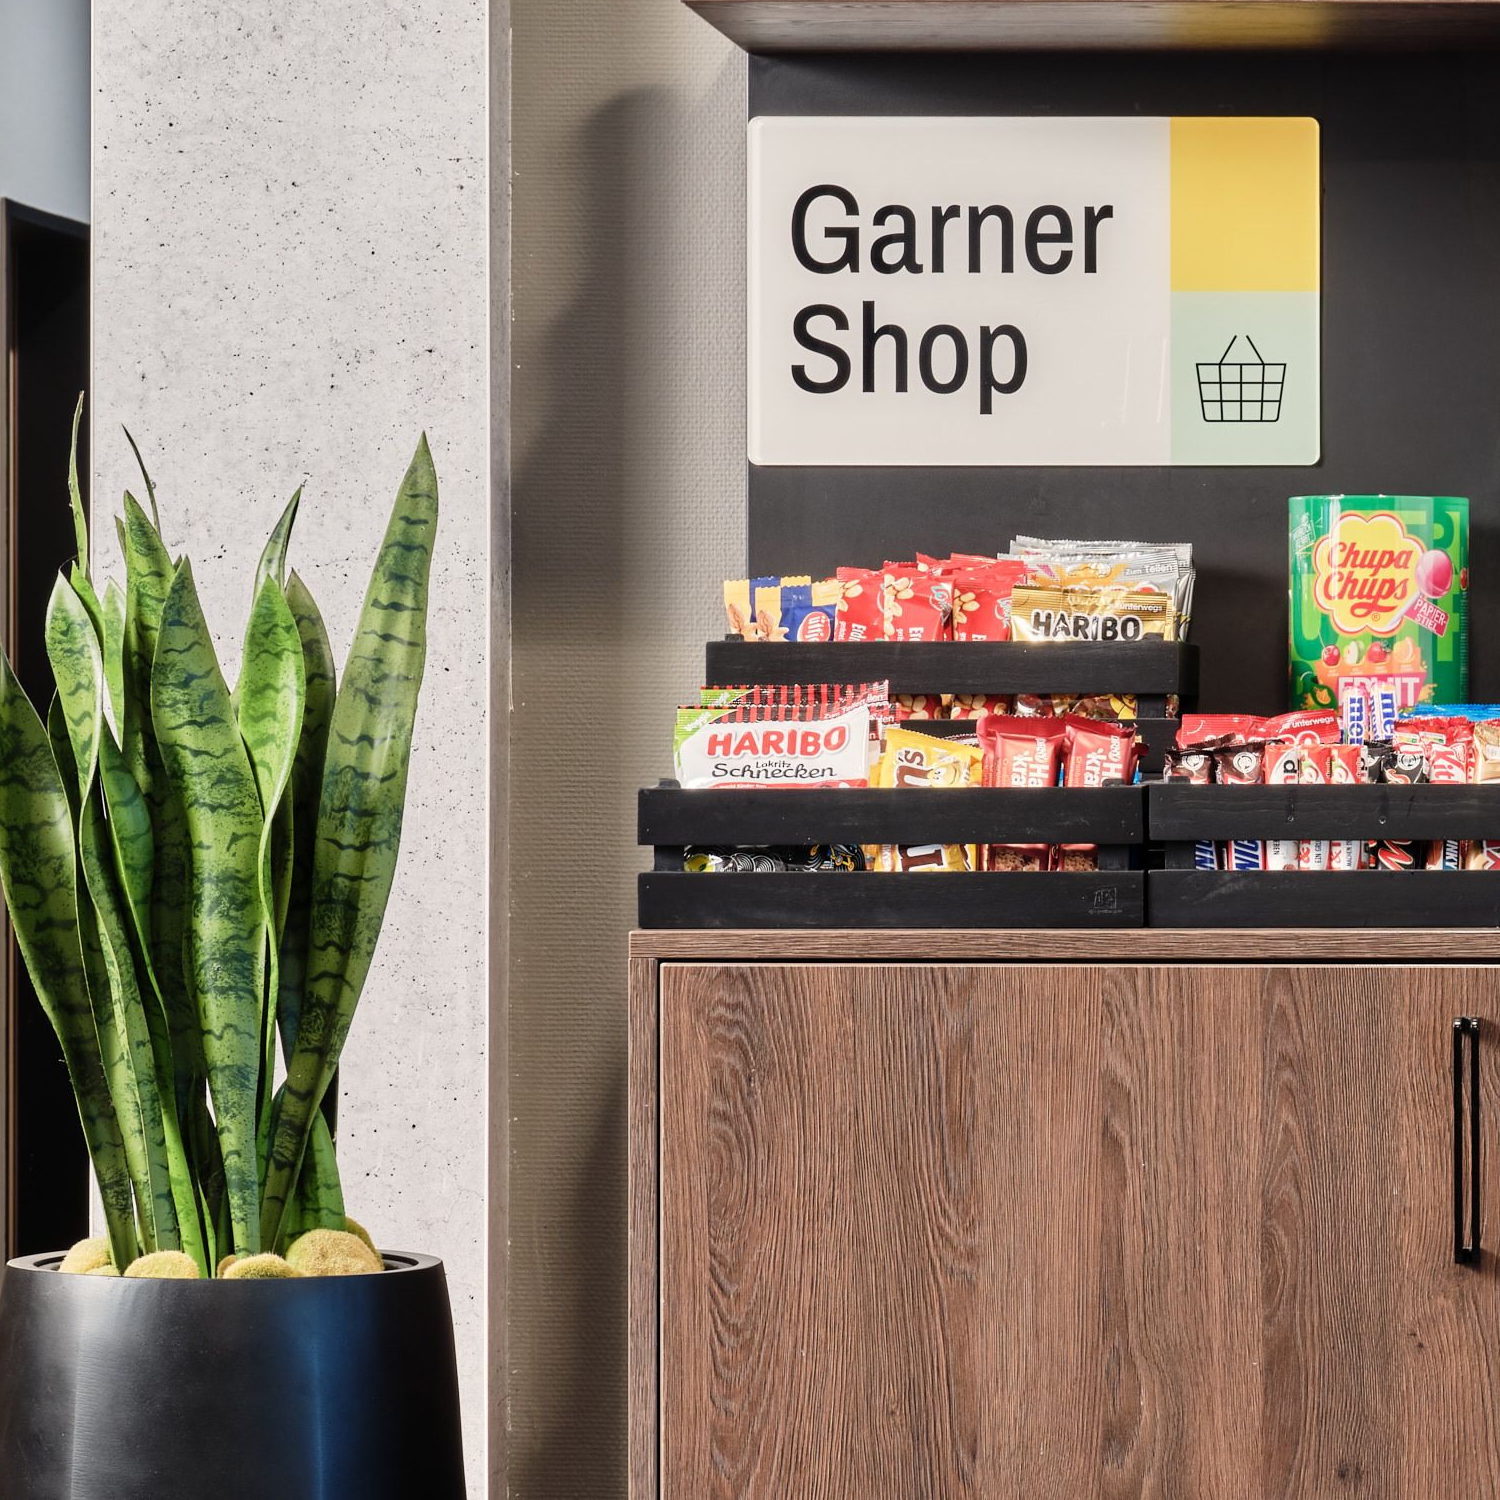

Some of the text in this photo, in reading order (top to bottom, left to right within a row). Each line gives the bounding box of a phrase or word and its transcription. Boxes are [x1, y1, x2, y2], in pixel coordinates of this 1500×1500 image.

[790, 183, 1114, 276] Garner
[790, 300, 1029, 415] Shop
[1327, 541, 1414, 577] Chupa
[1323, 571, 1409, 618] Chups
[1032, 609, 1142, 642] HARIBO
[706, 725, 847, 757] HARIBO
[711, 762, 837, 779] Schnecken
[755, 760, 791, 769] Lakritz
